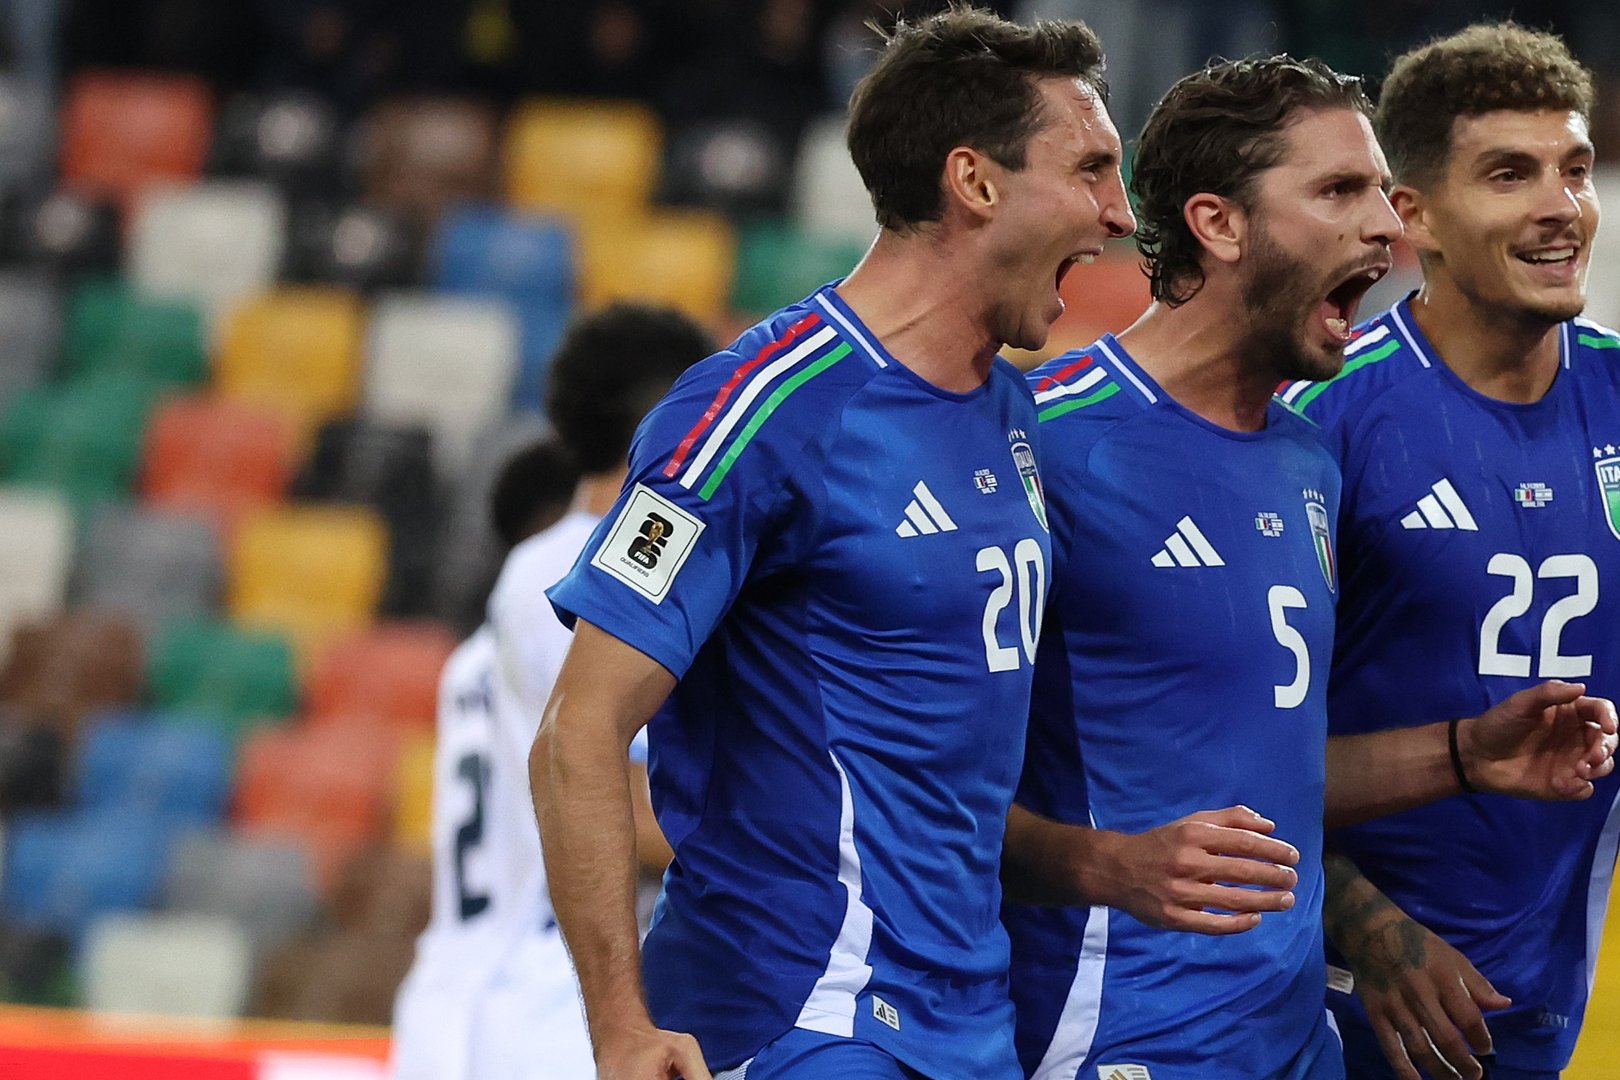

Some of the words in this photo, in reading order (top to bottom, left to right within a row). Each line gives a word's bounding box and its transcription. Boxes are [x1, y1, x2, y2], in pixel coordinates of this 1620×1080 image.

[634, 551, 650, 564] FIFA
[976, 538, 1044, 673] 20
[1478, 552, 1599, 678] 22
[1267, 585, 1310, 708] 5
[457, 752, 493, 921] 2
